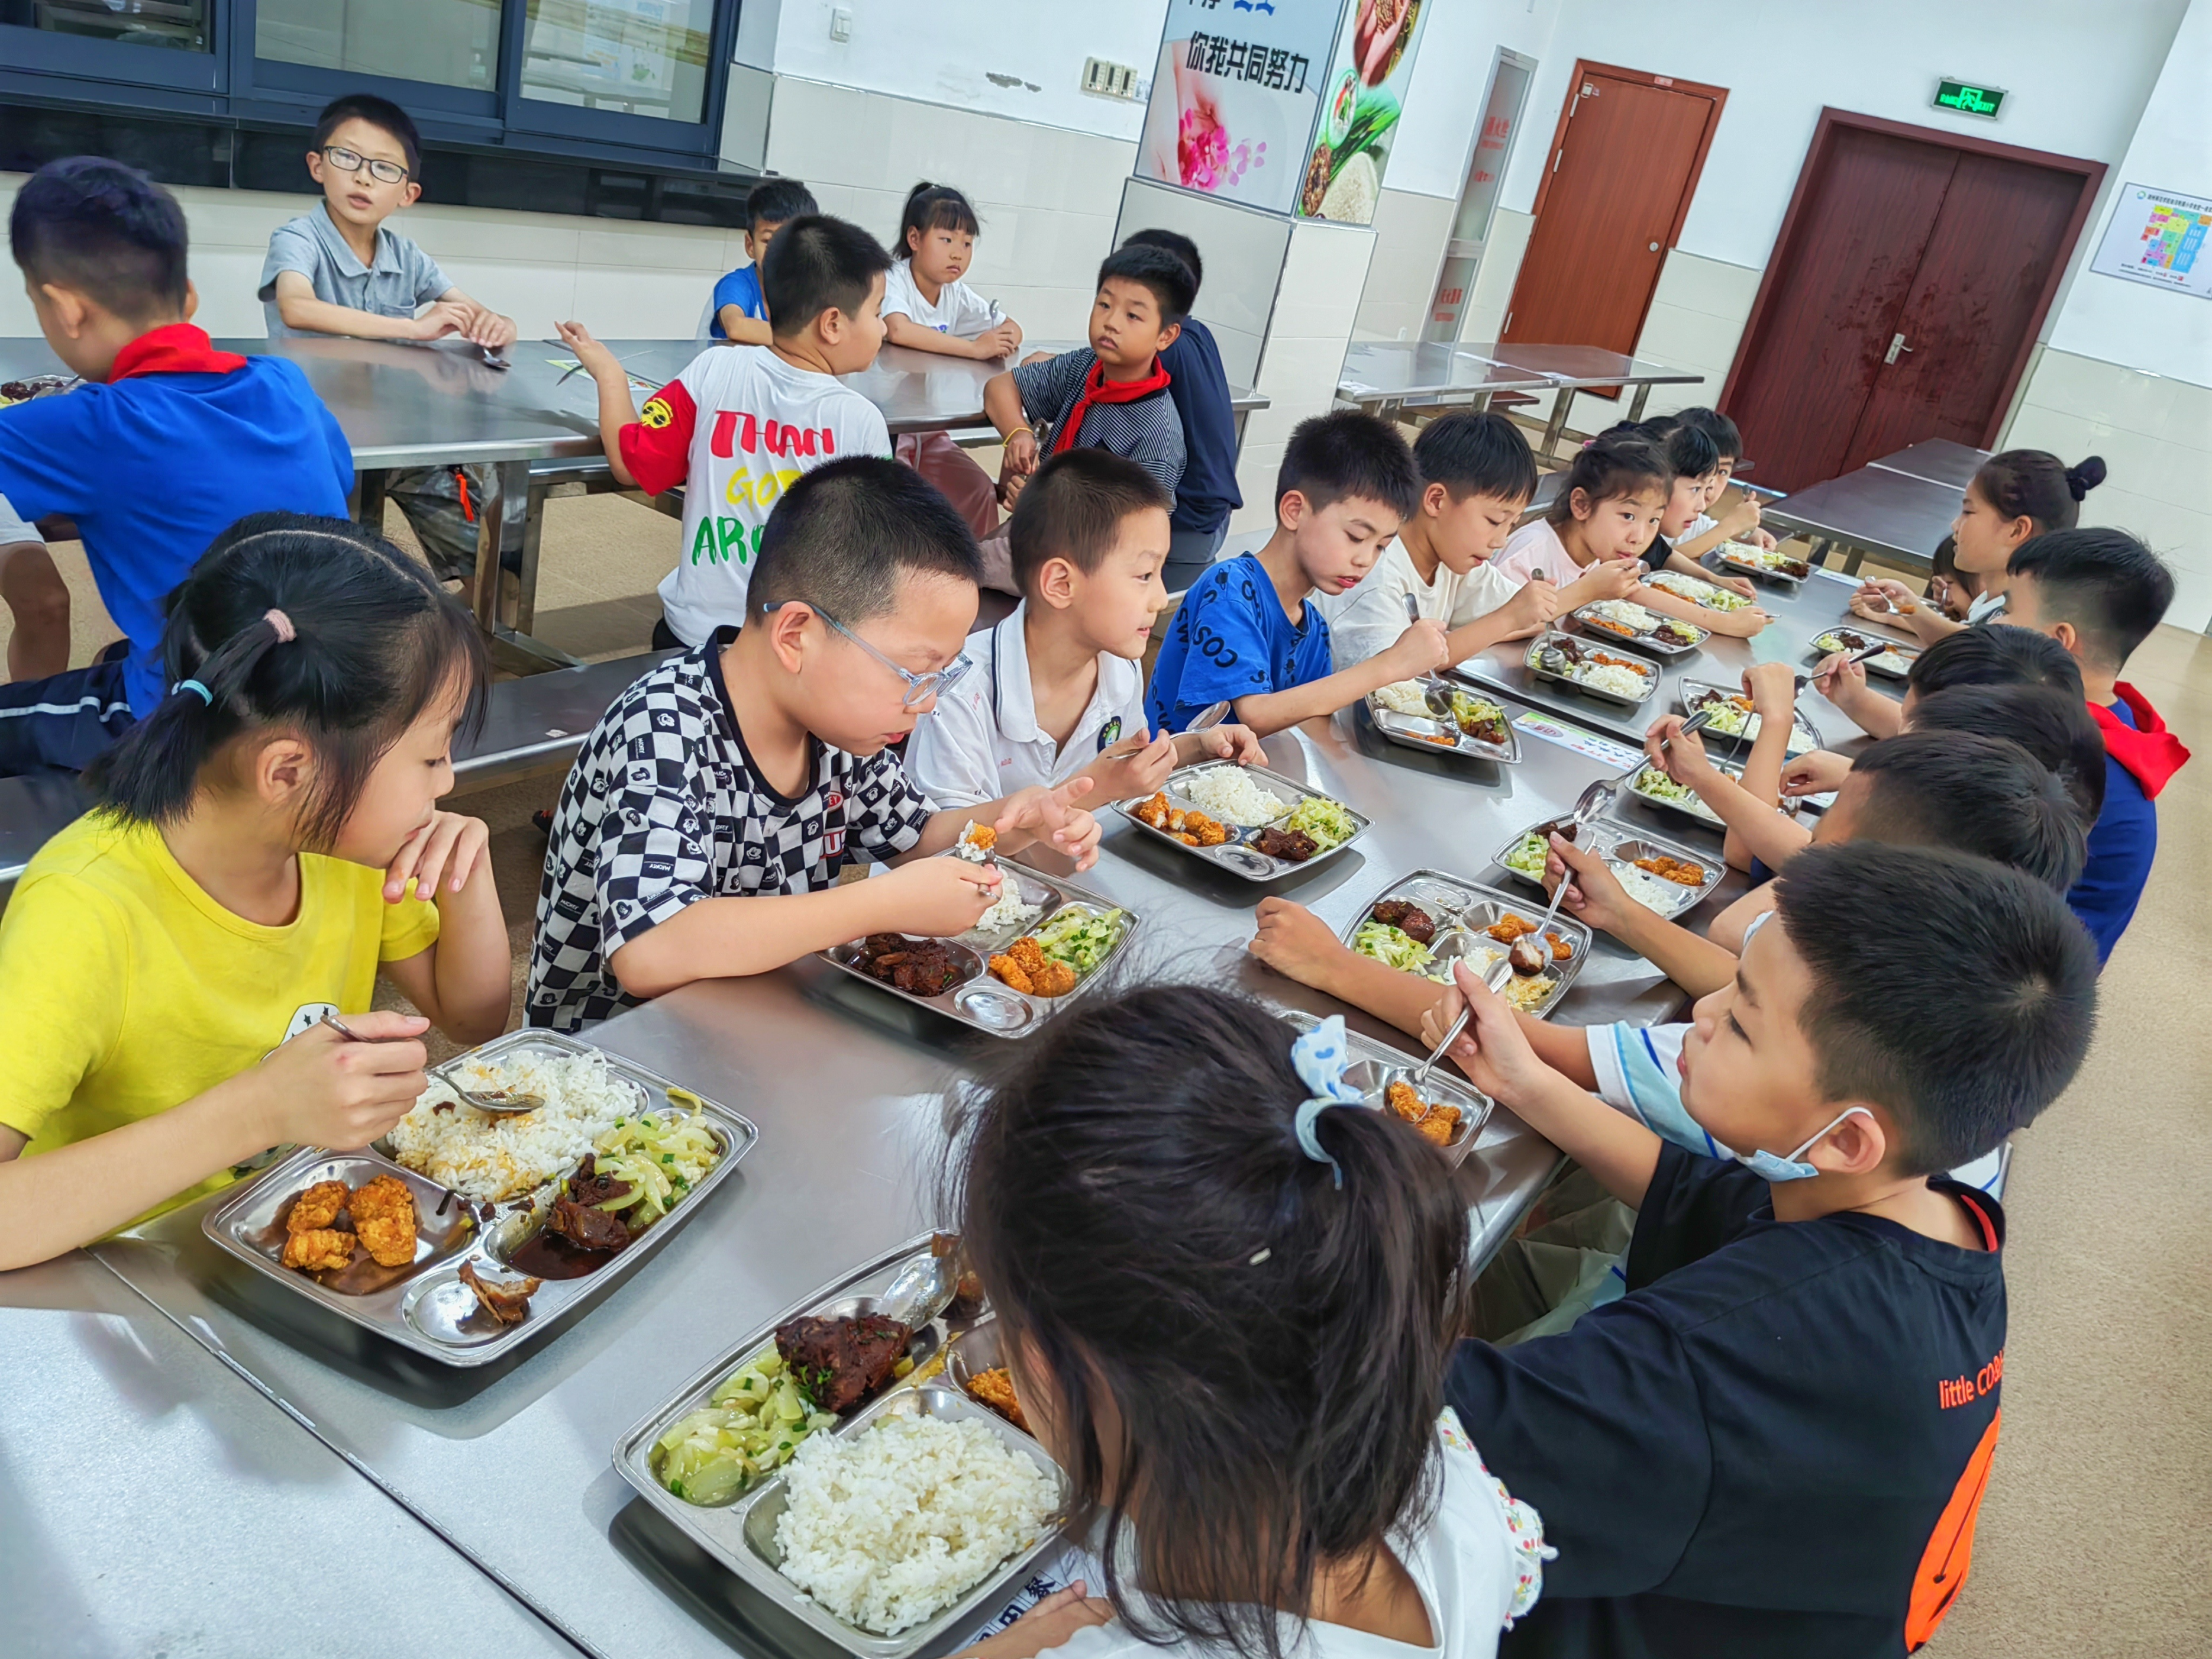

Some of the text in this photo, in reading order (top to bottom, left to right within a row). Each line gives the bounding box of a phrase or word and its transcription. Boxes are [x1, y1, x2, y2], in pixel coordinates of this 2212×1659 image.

[1186, 31, 1309, 93] 你我共同努力
[649, 863, 671, 872] MICKEY
[1939, 1374, 1975, 1410] little
